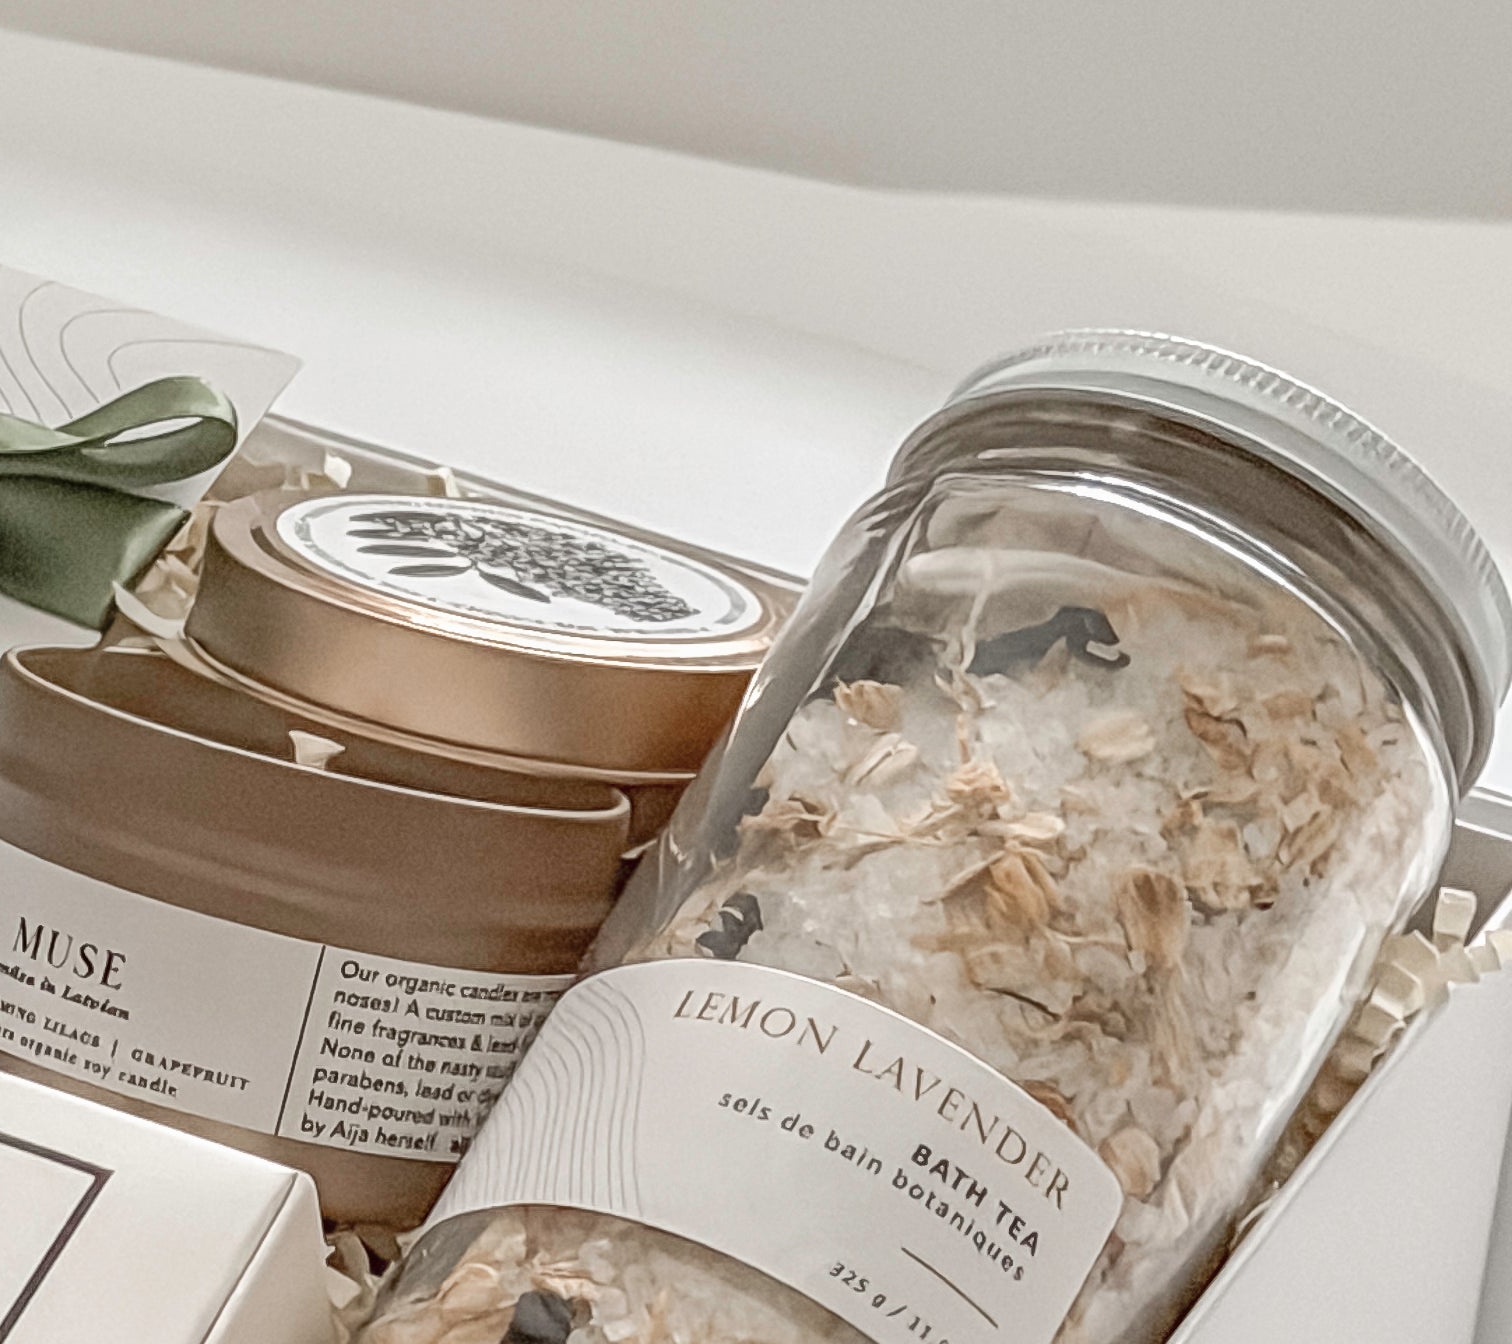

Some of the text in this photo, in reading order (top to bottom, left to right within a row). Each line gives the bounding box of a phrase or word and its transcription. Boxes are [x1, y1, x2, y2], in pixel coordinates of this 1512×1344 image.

[12, 916, 128, 991] MUSE
[340, 960, 381, 984] Our
[385, 972, 457, 997] organic
[327, 1010, 366, 1035] fine
[404, 998, 421, 1019] A
[131, 1047, 252, 1092] GRAPEFRUIT
[319, 1037, 377, 1064] None
[406, 1053, 437, 1076] the
[117, 1070, 179, 1098] candle
[672, 988, 1071, 1211] LEMON LAVENDER
[300, 1112, 327, 1137] by
[780, 1112, 815, 1140] de
[823, 1129, 884, 1176] bain
[891, 1168, 1026, 1282] botaniques
[910, 1143, 1041, 1258] BATH TEA
[828, 1260, 871, 1295] 325
